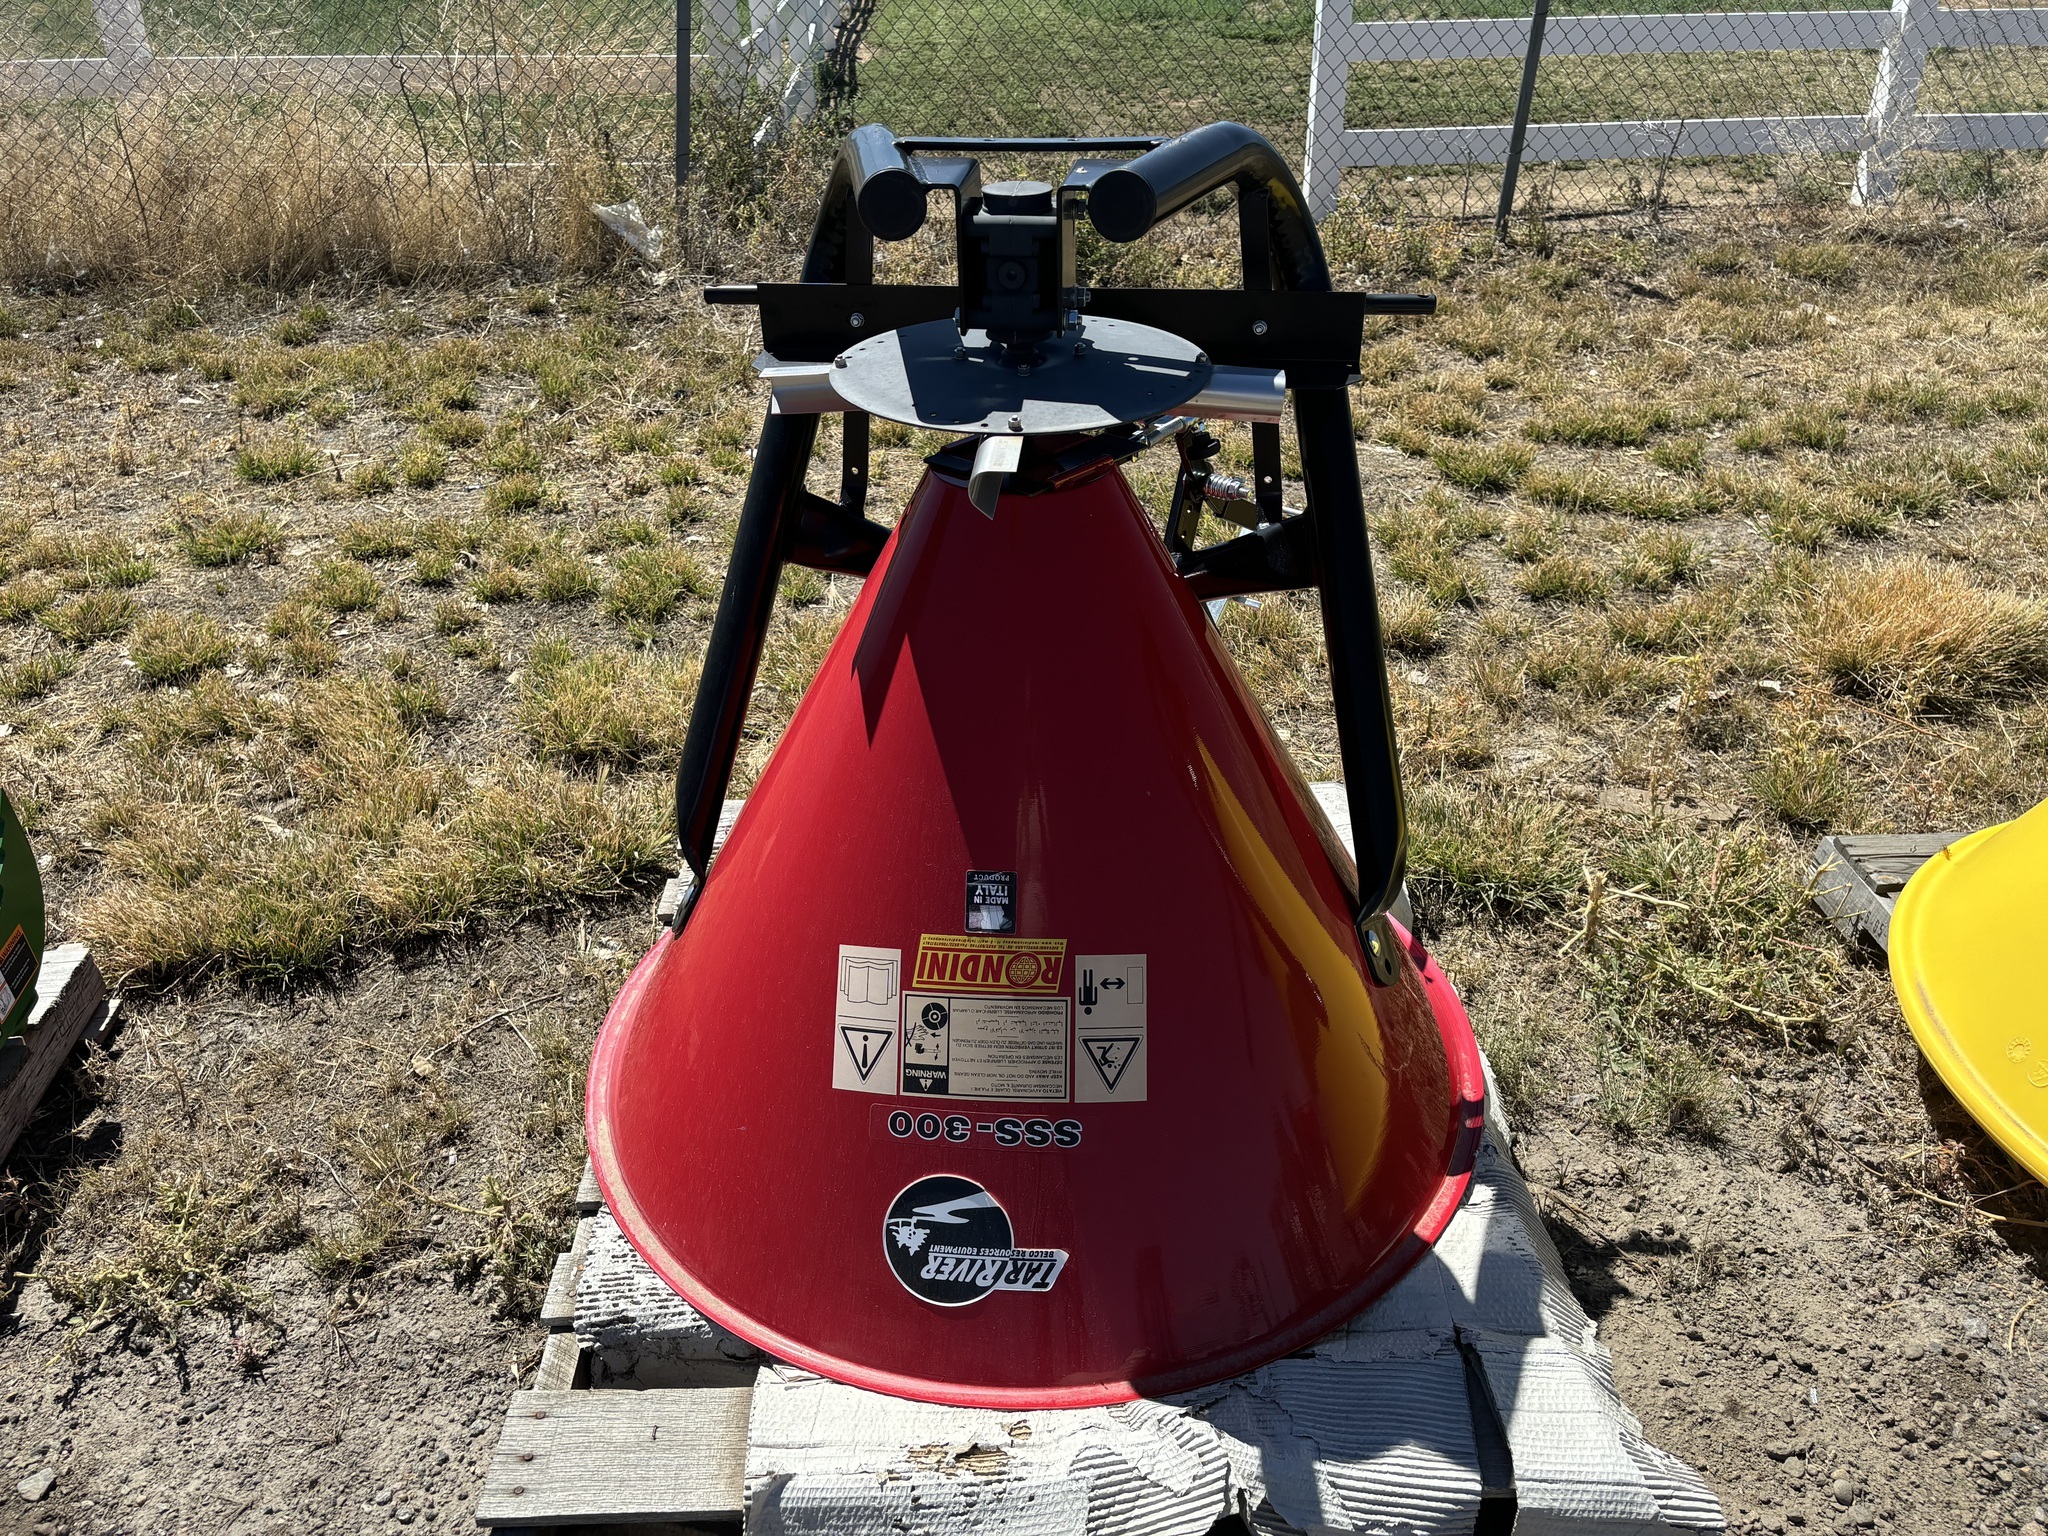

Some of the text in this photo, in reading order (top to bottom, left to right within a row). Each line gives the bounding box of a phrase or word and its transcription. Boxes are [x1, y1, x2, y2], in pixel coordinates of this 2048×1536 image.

[974, 896, 1009, 904] MADE IN
[975, 885, 1008, 896] ITALY
[2, 929, 22, 961] WARNING
[917, 952, 1062, 989] RONDINI
[905, 1069, 946, 1079] WARNING
[888, 1111, 1082, 1148] SSS-300
[928, 1244, 1054, 1258] BELCO RESOURCES EQUIPMENT
[920, 1255, 1056, 1289] TAR RIVER
